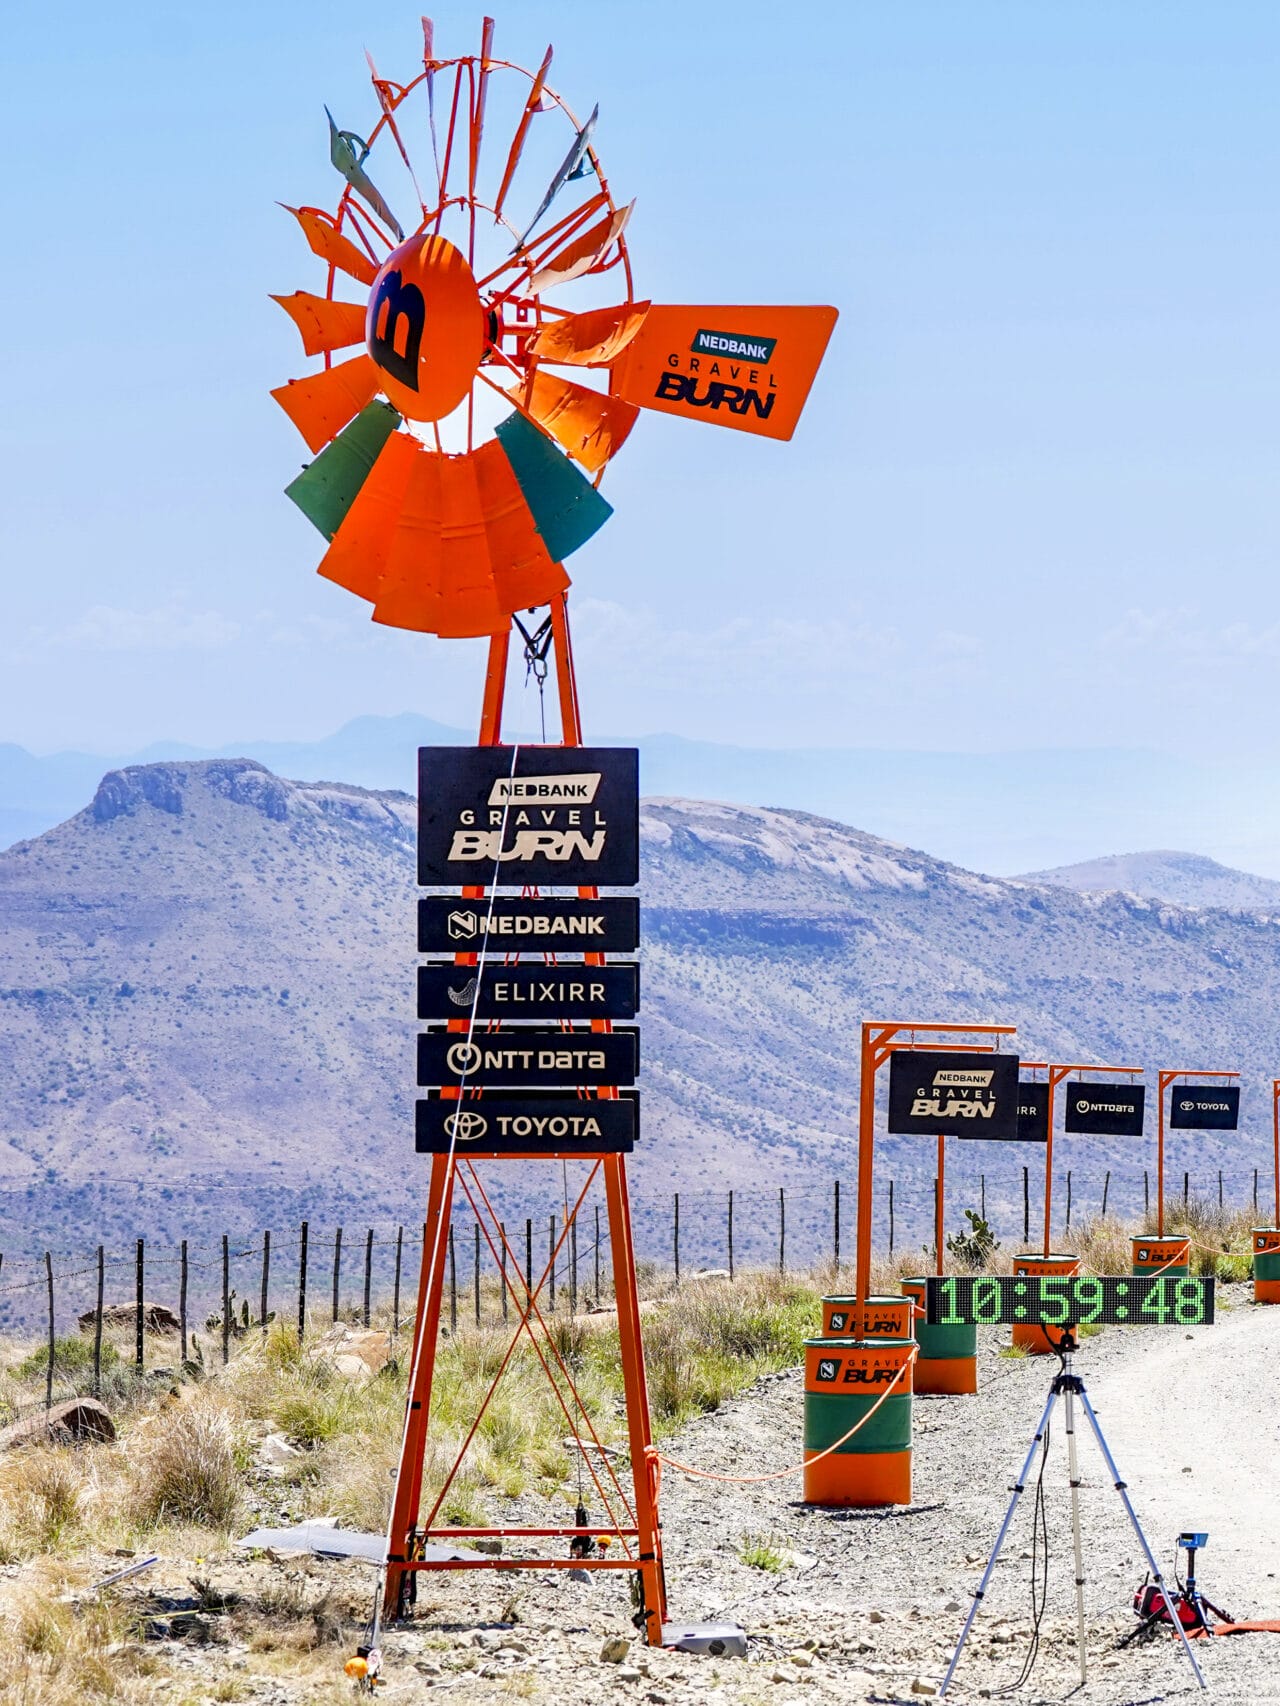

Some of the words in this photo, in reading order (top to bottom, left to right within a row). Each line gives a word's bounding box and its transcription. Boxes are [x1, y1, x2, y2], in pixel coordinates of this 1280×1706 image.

[699, 333, 768, 360] NEDBANK
[668, 353, 778, 388] GRAVEL
[655, 371, 777, 420] BURN
[500, 784, 588, 797] NEDBANK
[460, 809, 607, 826] GRAVEL
[447, 830, 607, 862] BURN
[479, 916, 606, 935] NEDBANK
[494, 983, 606, 1001] ELIXIRR
[484, 1050, 534, 1069] NTT
[939, 1073, 988, 1084] NEDBANK
[916, 1087, 997, 1099] GRAVEL
[909, 1099, 997, 1118] BURN
[1196, 1102, 1230, 1111] TOYOTA
[496, 1116, 602, 1136] TOYOTA
[941, 1277, 1204, 1324] 10:59:48
